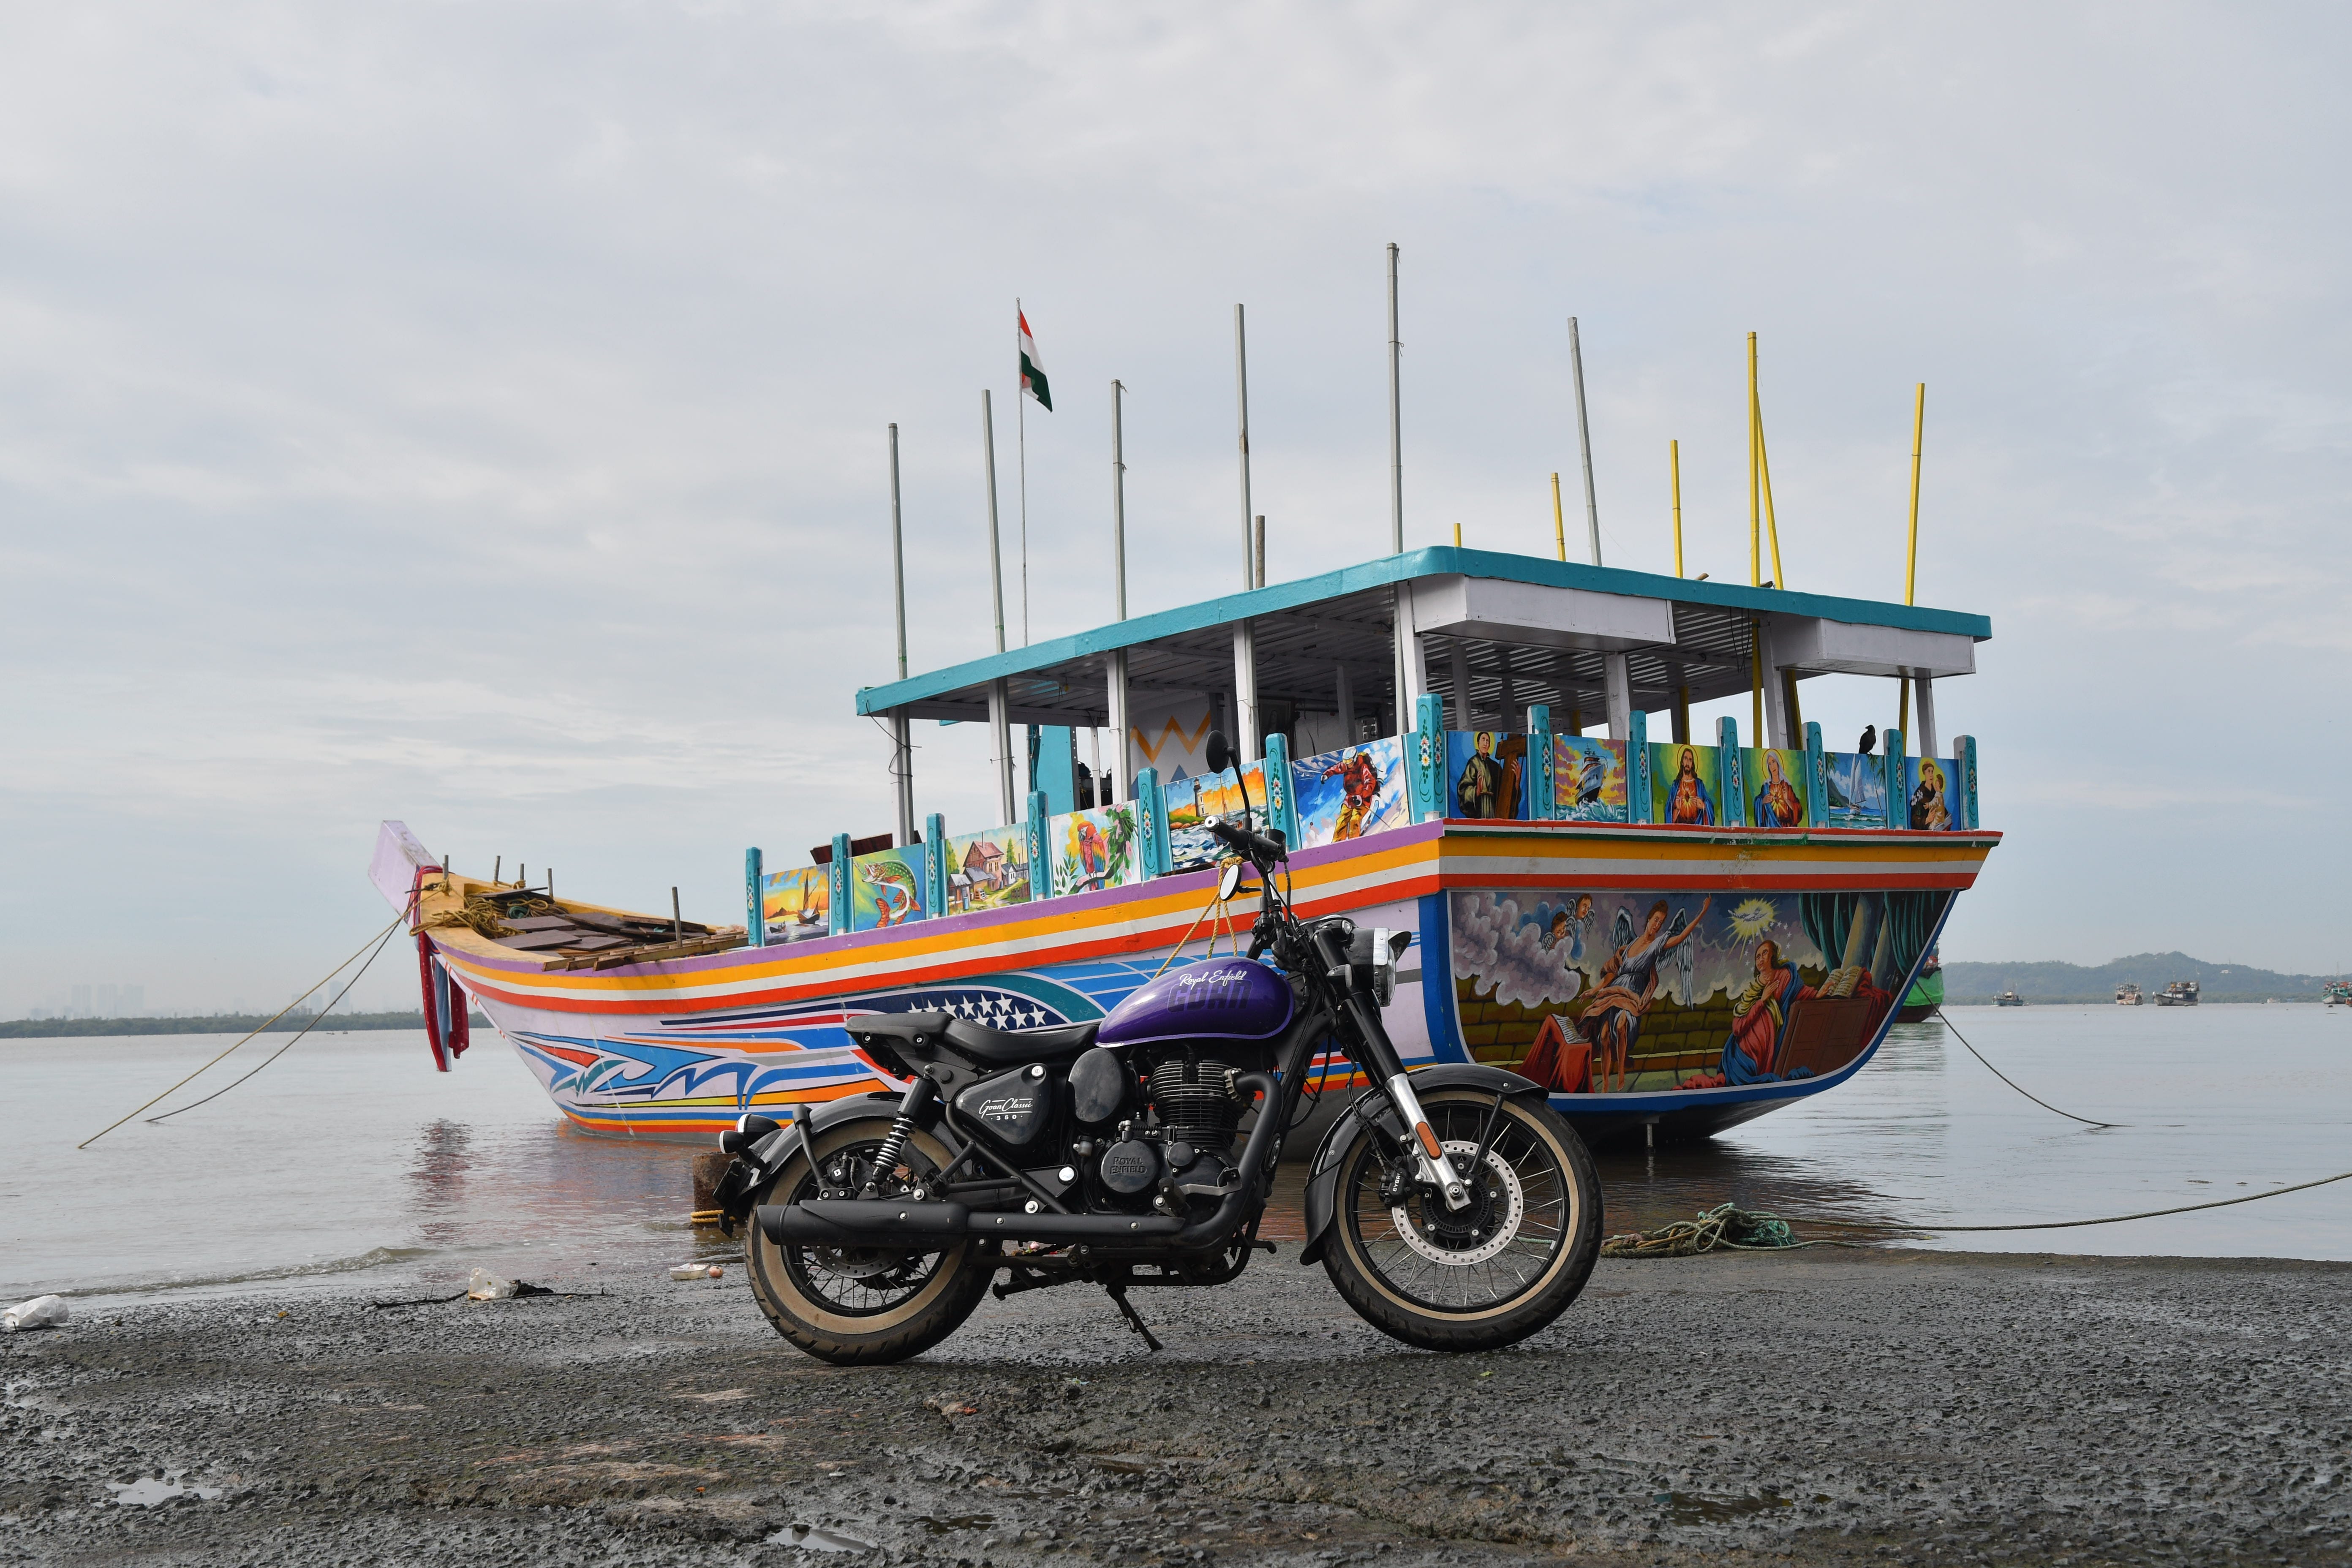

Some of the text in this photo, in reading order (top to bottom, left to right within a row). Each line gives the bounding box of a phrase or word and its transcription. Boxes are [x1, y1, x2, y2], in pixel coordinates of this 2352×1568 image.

[1179, 970, 1247, 990] Royal Enfield
[979, 1097, 1033, 1119] Goan Classic
[1113, 1157, 1143, 1165] ROYAL
[1110, 1165, 1147, 1174] ENFIELD
